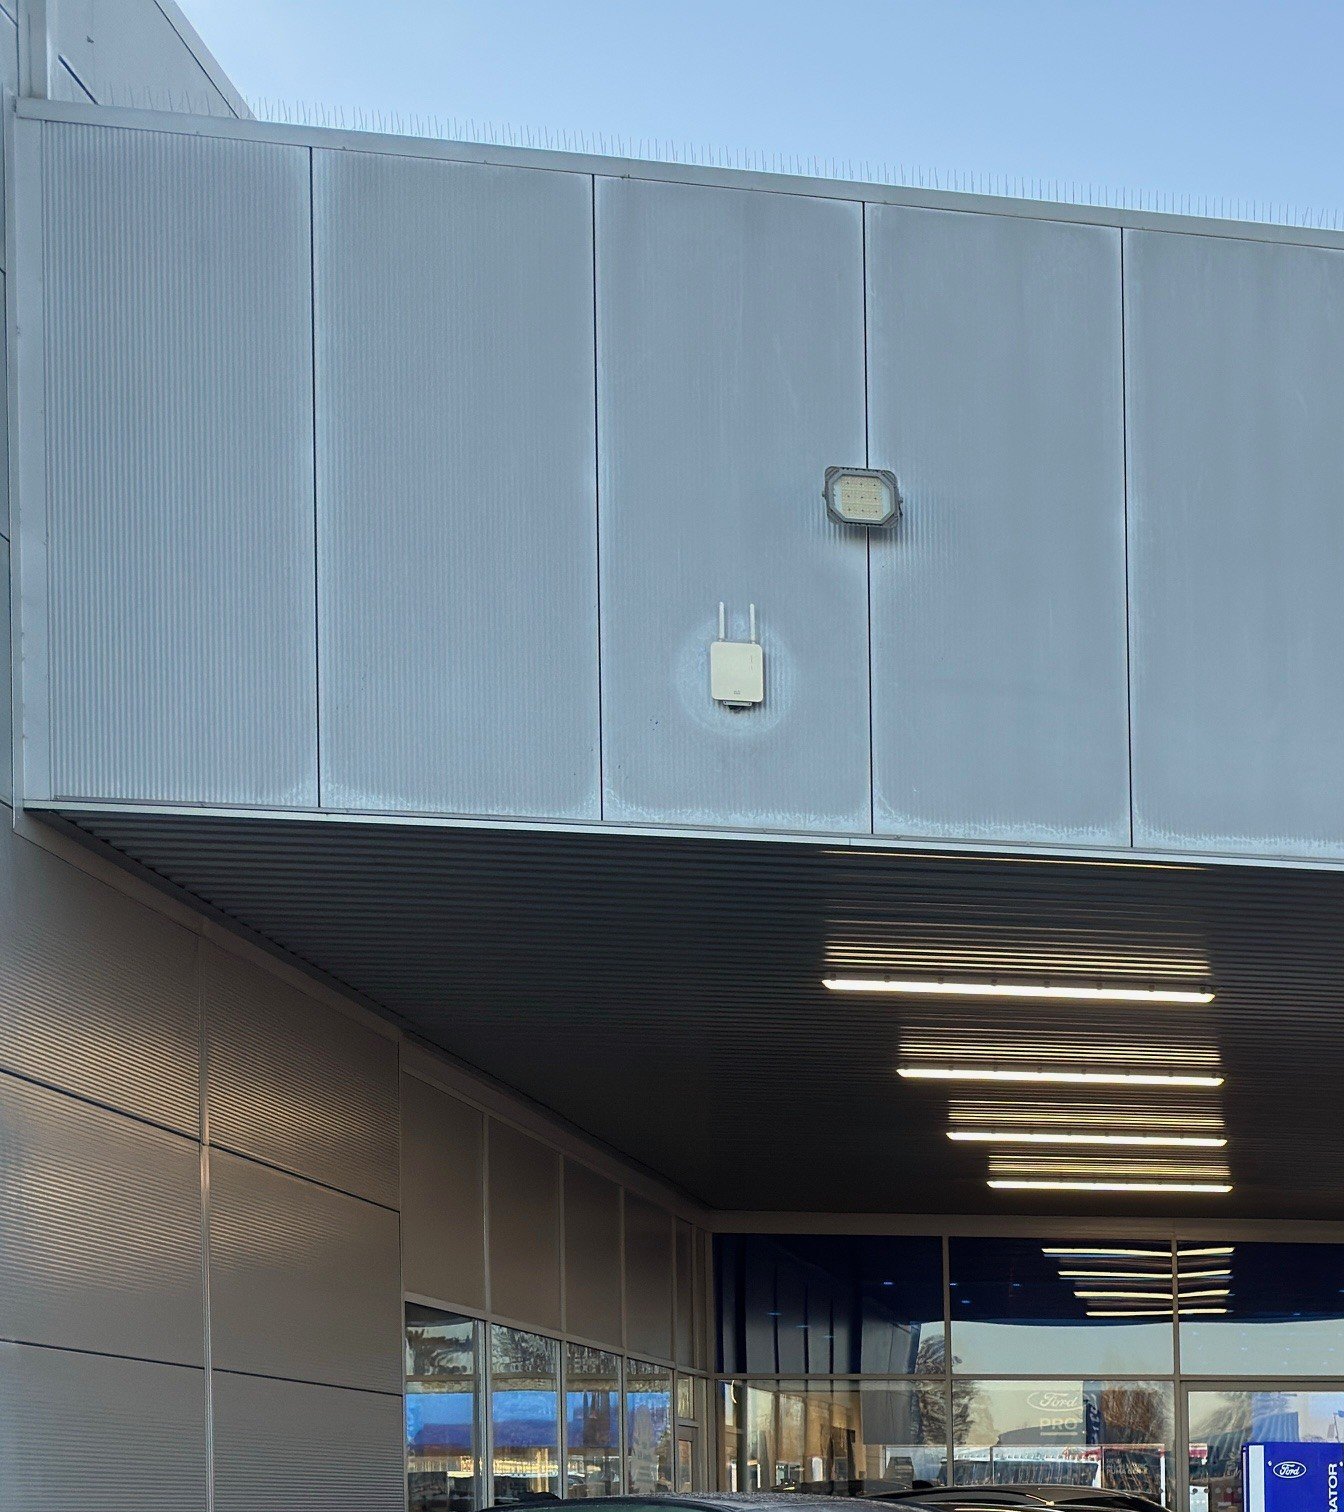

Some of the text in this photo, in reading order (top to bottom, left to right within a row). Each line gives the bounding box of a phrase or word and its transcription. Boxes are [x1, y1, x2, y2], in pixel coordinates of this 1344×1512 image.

[1040, 1392, 1078, 1407] Ford
[1040, 1418, 1078, 1430] PRO
[1279, 1463, 1300, 1476] Ford
